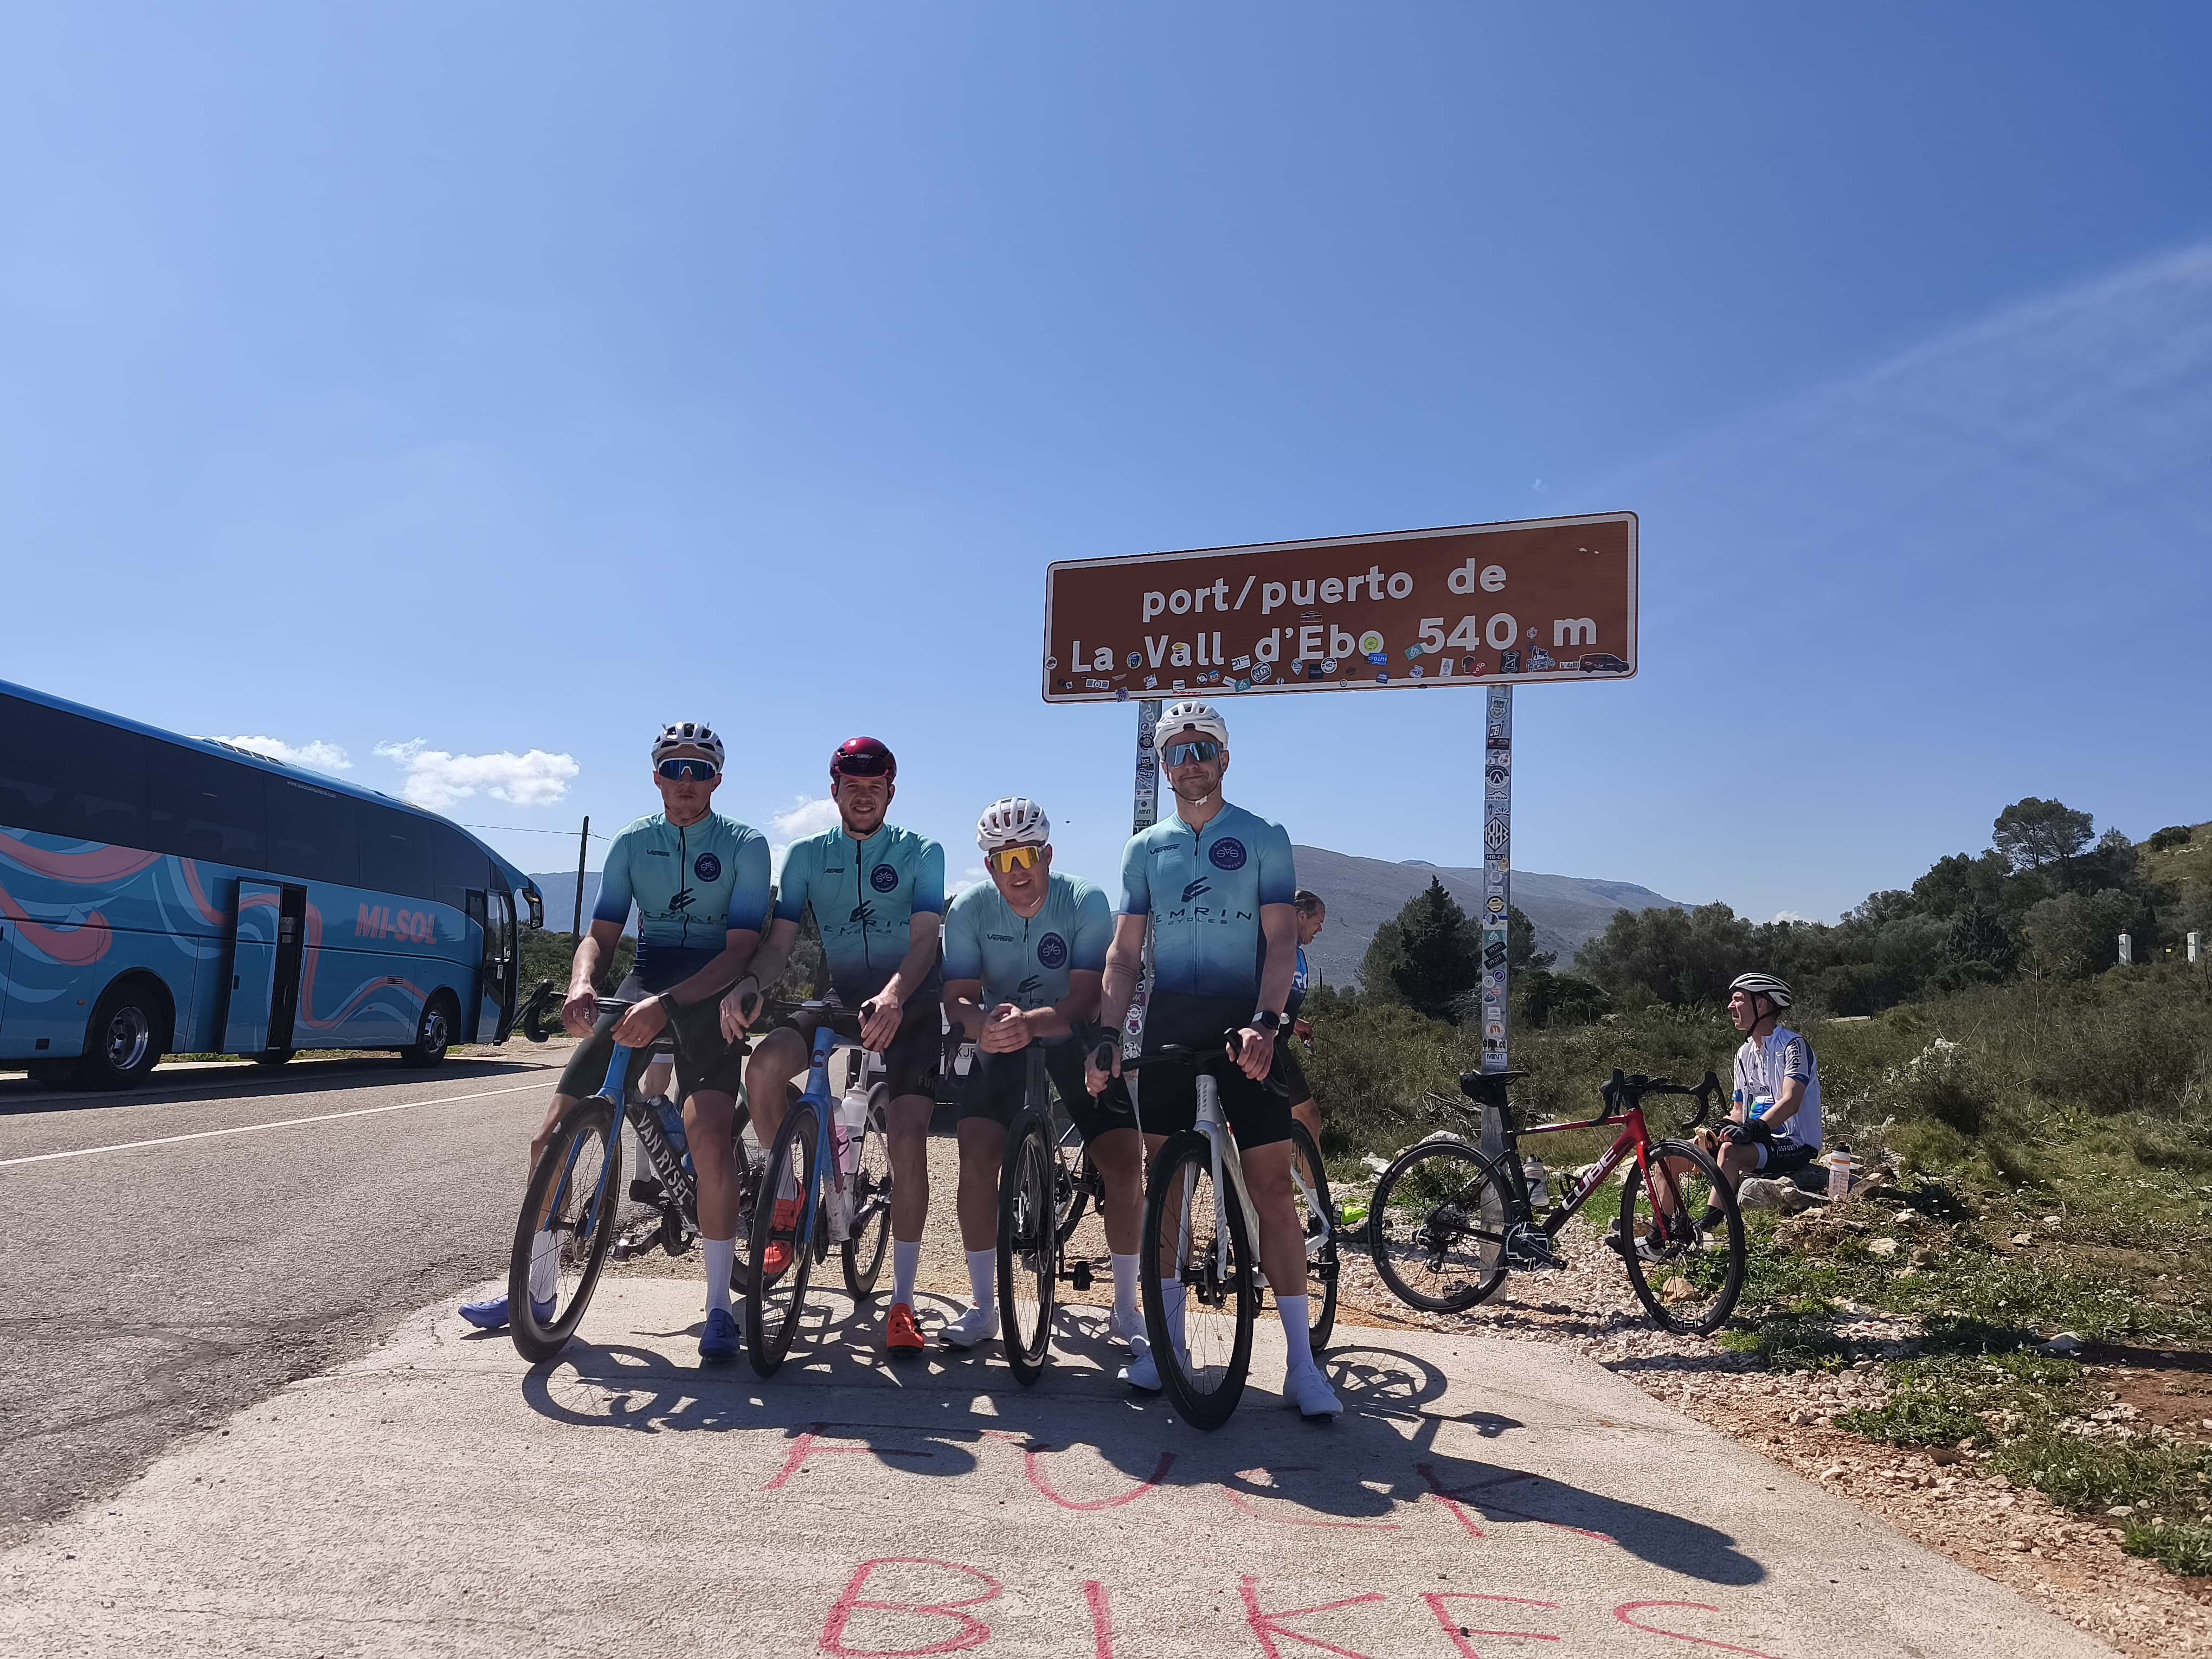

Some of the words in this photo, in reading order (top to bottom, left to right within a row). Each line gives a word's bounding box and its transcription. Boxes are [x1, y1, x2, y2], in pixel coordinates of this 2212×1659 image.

[1142, 565, 1413, 622] port/puerto
[1447, 558, 1506, 595] de
[1072, 640, 1114, 672] La
[1144, 632, 1224, 668] Vall
[1418, 613, 1517, 654] 540
[1554, 618, 1597, 646] m
[1150, 844, 1180, 854] VERGE
[356, 903, 437, 944] MI-SOL
[1155, 906, 1252, 923] EMRIN
[637, 1111, 662, 1153] VAN
[656, 1149, 688, 1205] RYSEL
[1562, 1146, 1617, 1211] CUBE
